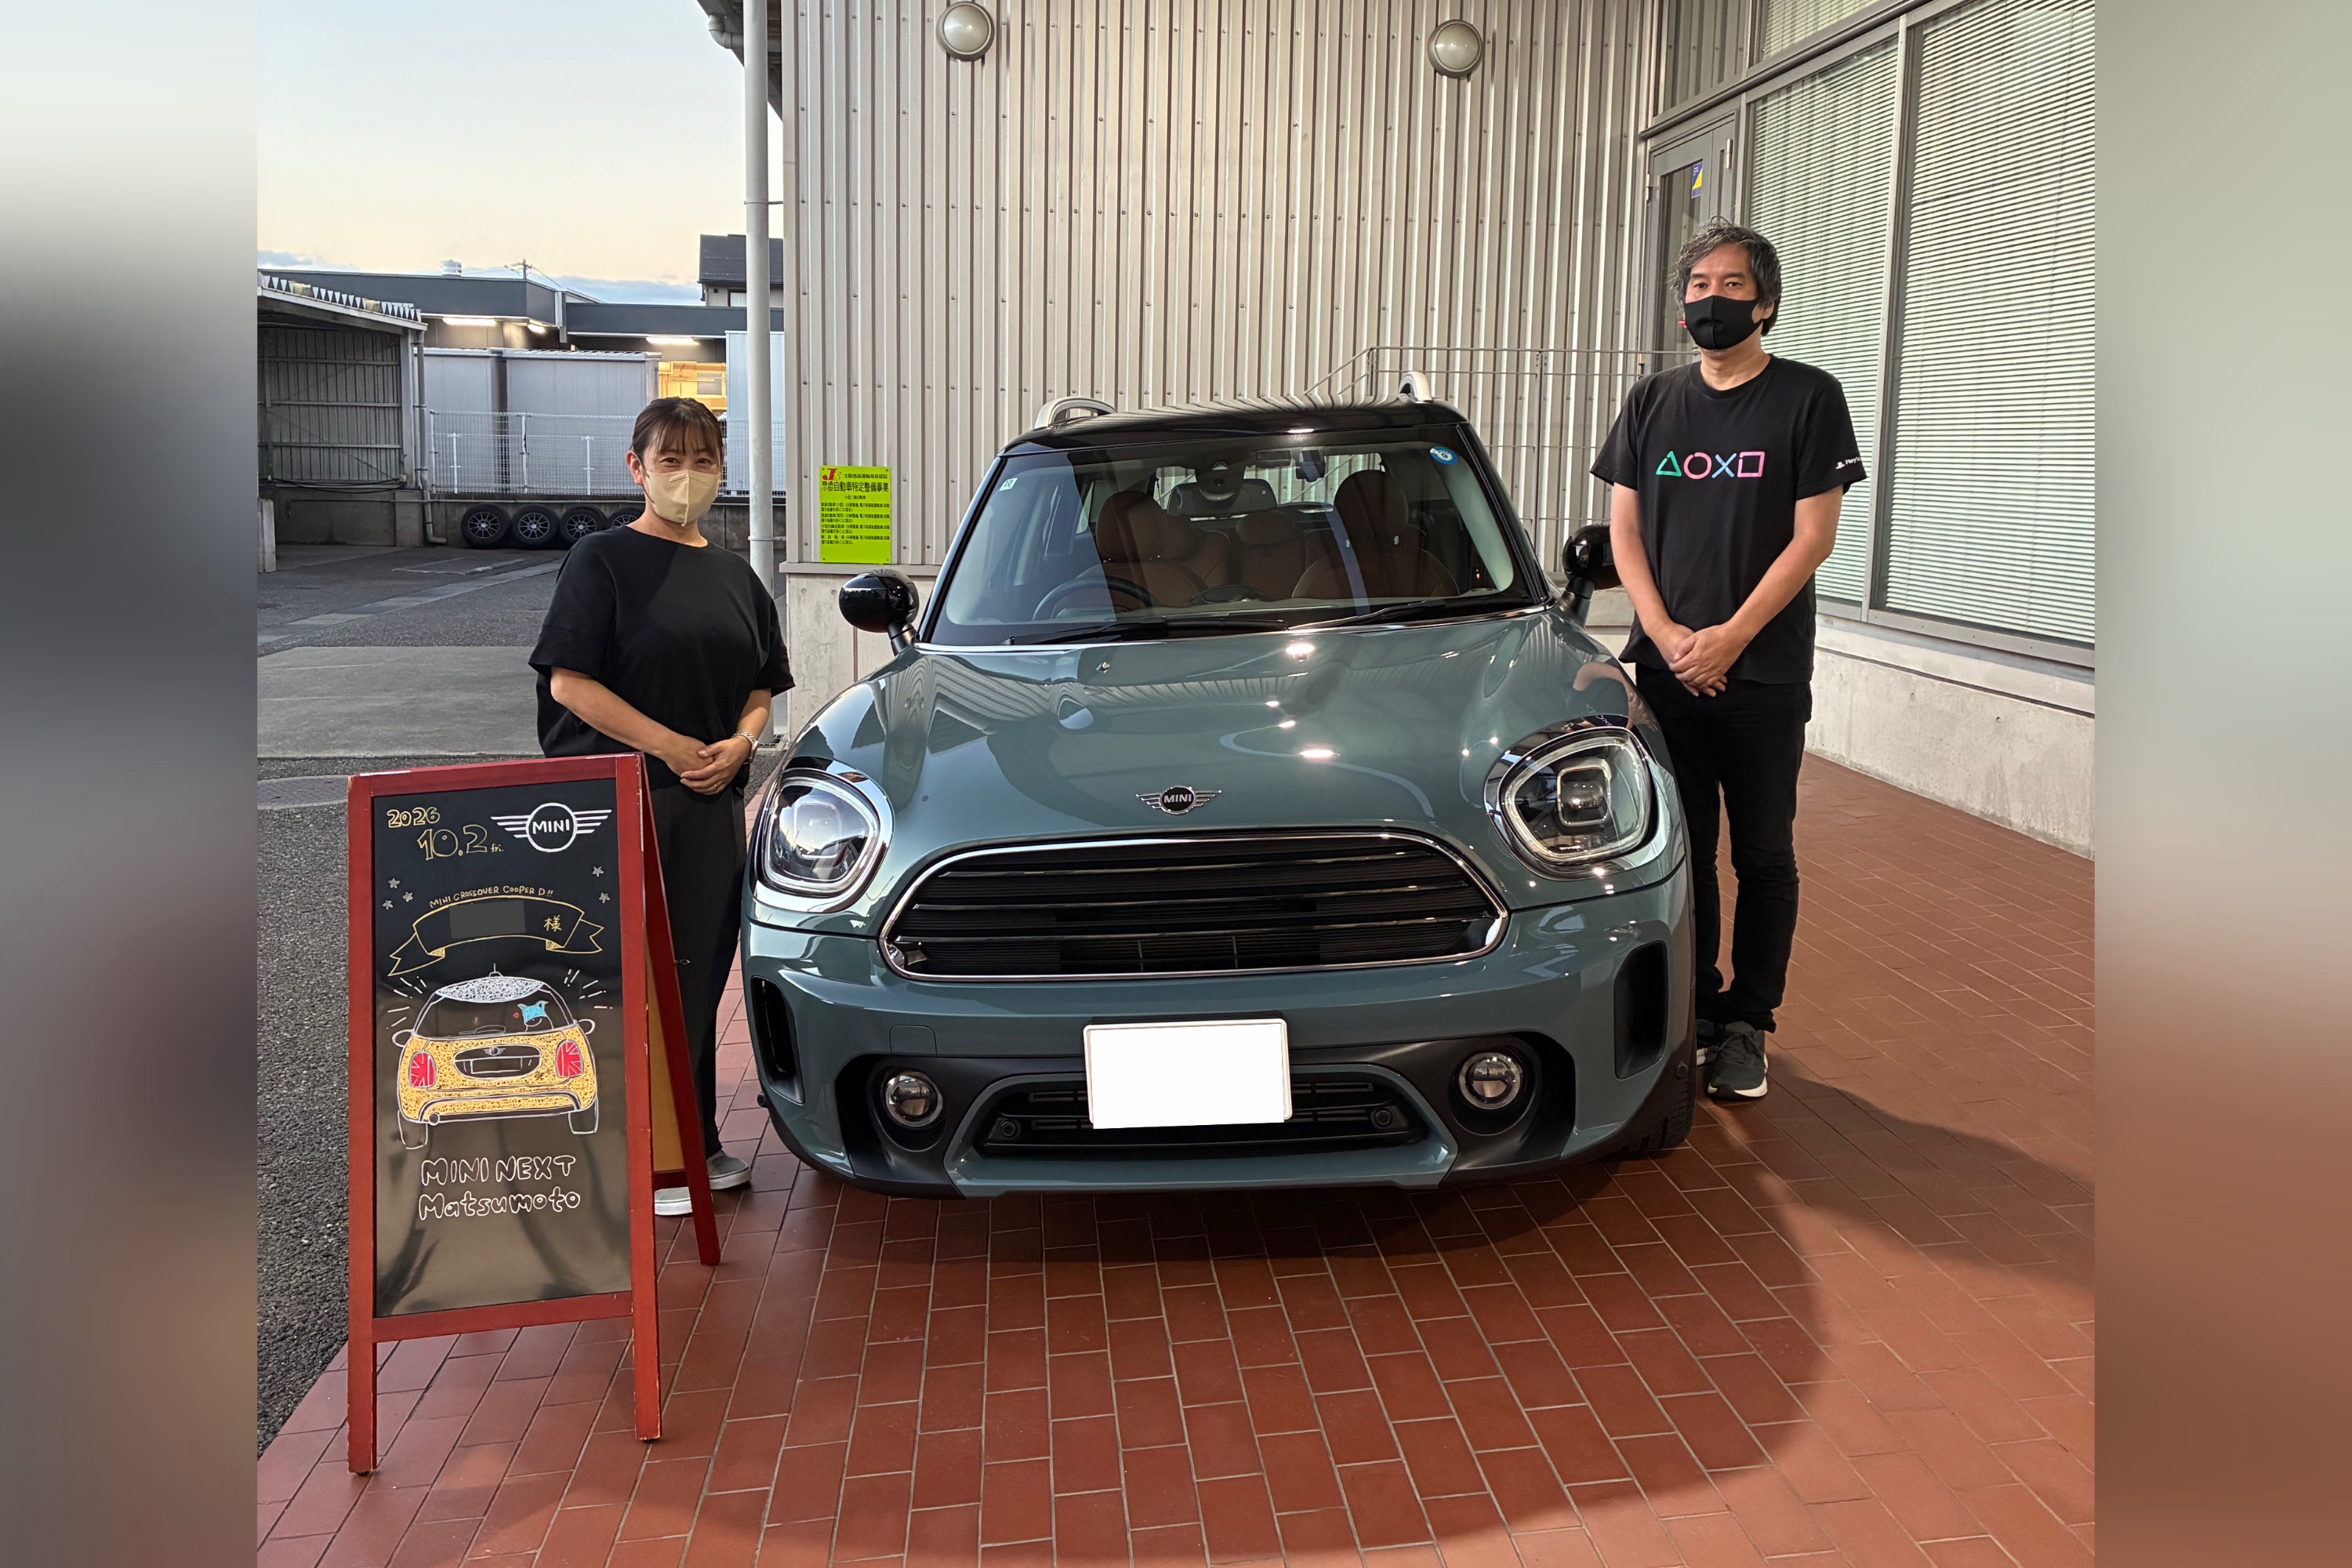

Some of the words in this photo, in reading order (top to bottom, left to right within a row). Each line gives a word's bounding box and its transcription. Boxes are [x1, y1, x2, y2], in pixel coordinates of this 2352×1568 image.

[1163, 793, 1192, 803] MINI
[387, 807, 441, 828] 2026
[532, 818, 570, 833] MINI
[417, 824, 488, 861] 10.2
[430, 895, 452, 909] MINI
[453, 886, 499, 902] CROSSOVER
[543, 914, 562, 931] 様
[421, 1157, 489, 1186] MINI
[495, 1155, 576, 1183] NEXT
[419, 1186, 581, 1220] Matsumoto
